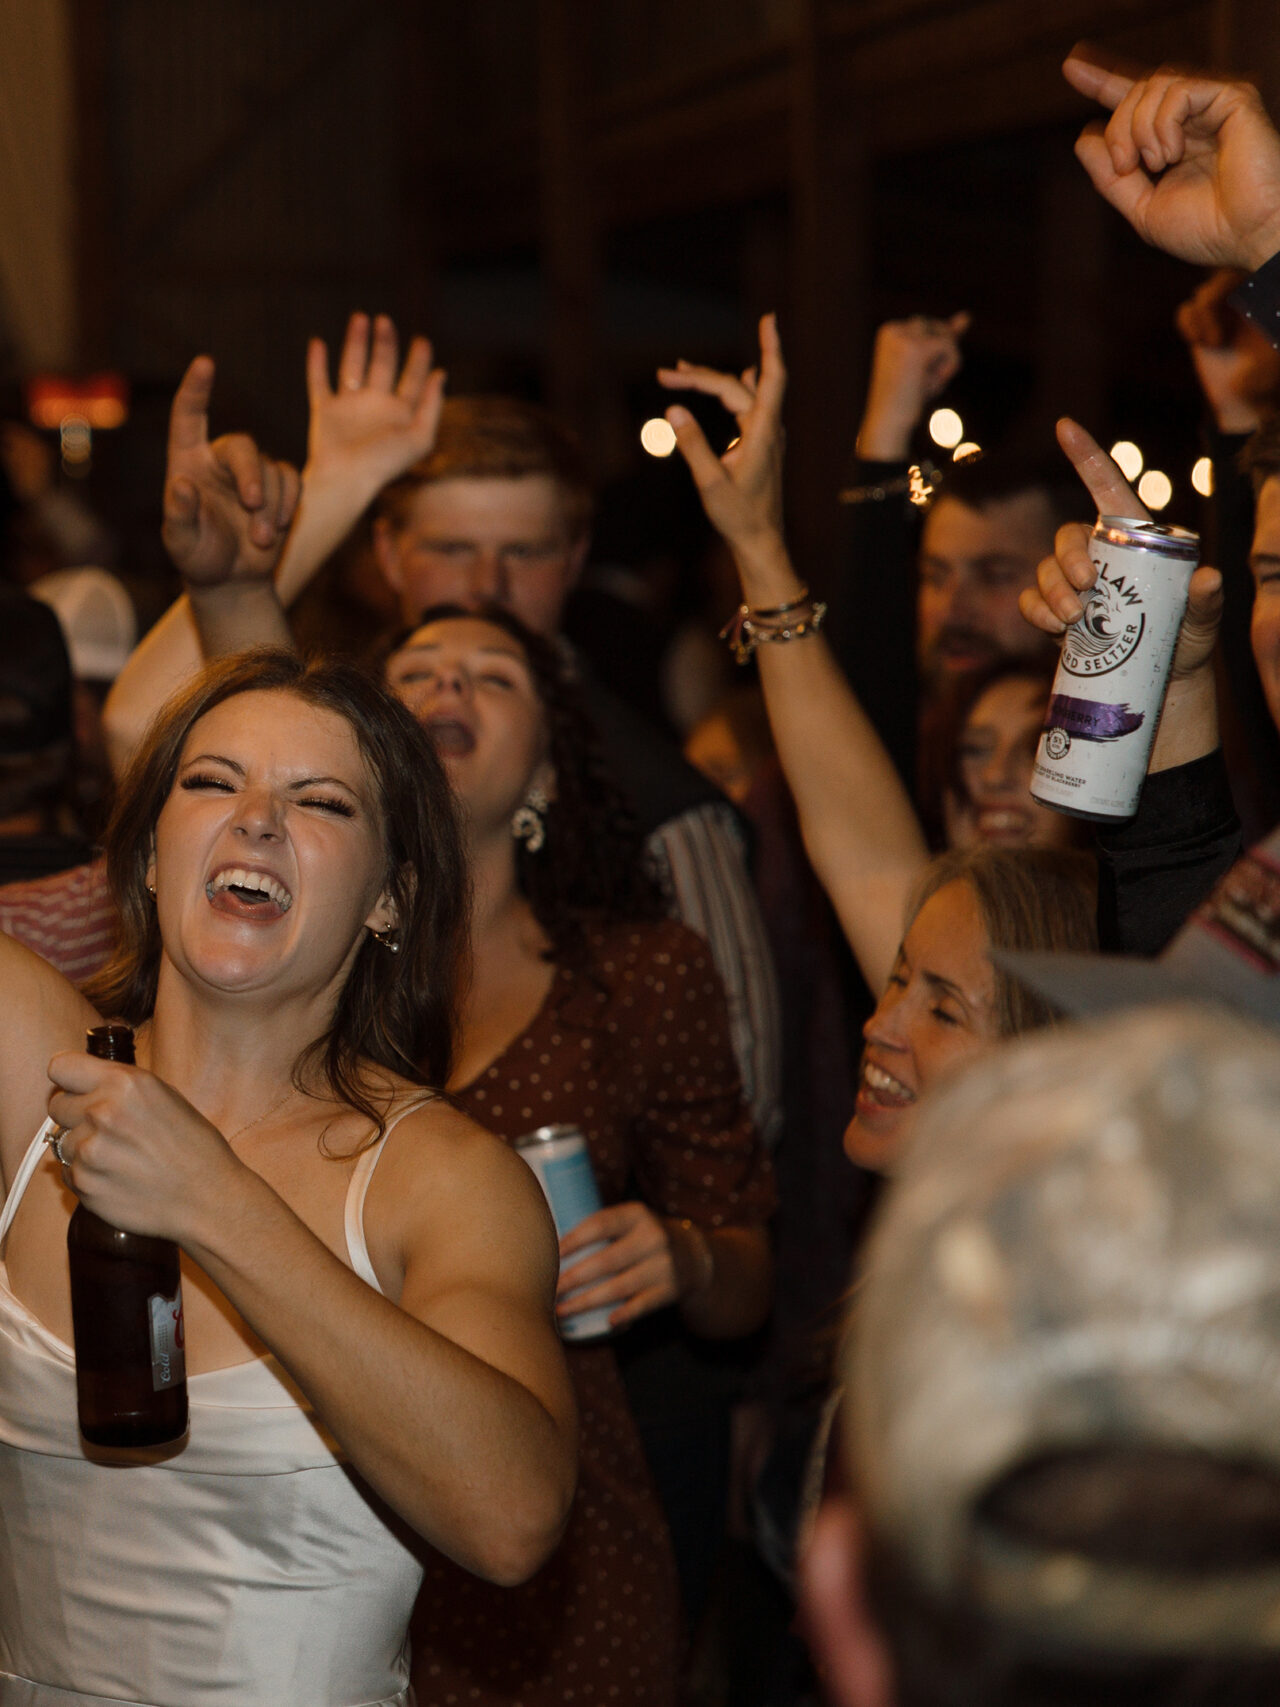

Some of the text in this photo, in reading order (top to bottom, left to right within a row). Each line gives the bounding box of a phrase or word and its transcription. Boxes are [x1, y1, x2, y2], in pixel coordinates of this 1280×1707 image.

[1085, 624, 1138, 671] SELTZER
[1066, 775, 1087, 785] WATER
[160, 1352, 171, 1384] Cold
